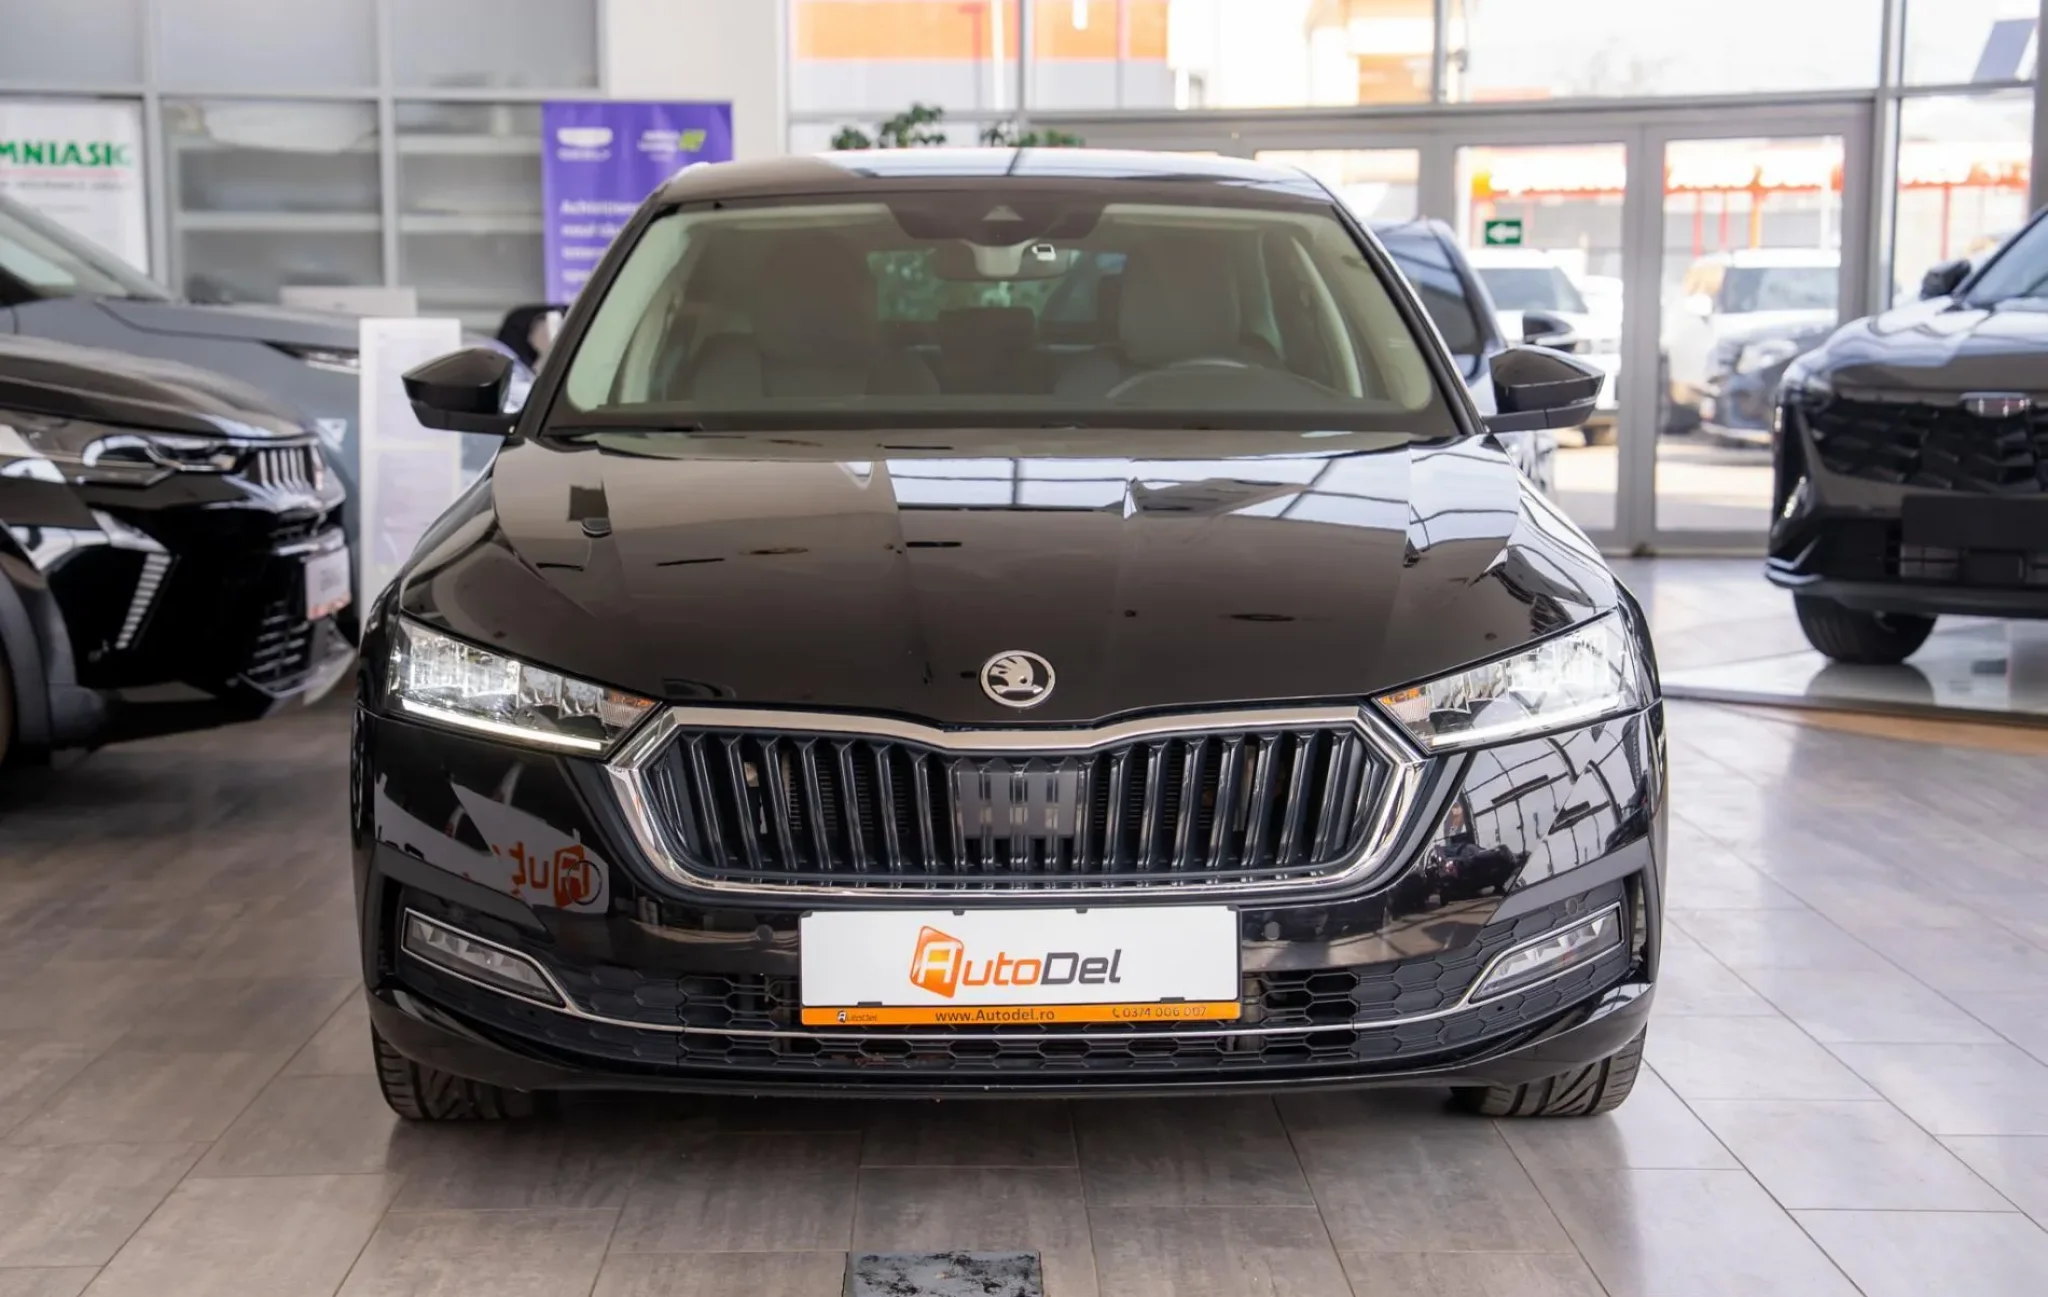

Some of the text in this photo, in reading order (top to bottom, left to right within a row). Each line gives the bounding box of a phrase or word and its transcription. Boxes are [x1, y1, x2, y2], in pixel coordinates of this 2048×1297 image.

[914, 938, 1122, 988] AutoDel
[935, 1008, 1055, 1021] www.Autodel.ro
[1122, 1007, 1151, 1018] 0374
